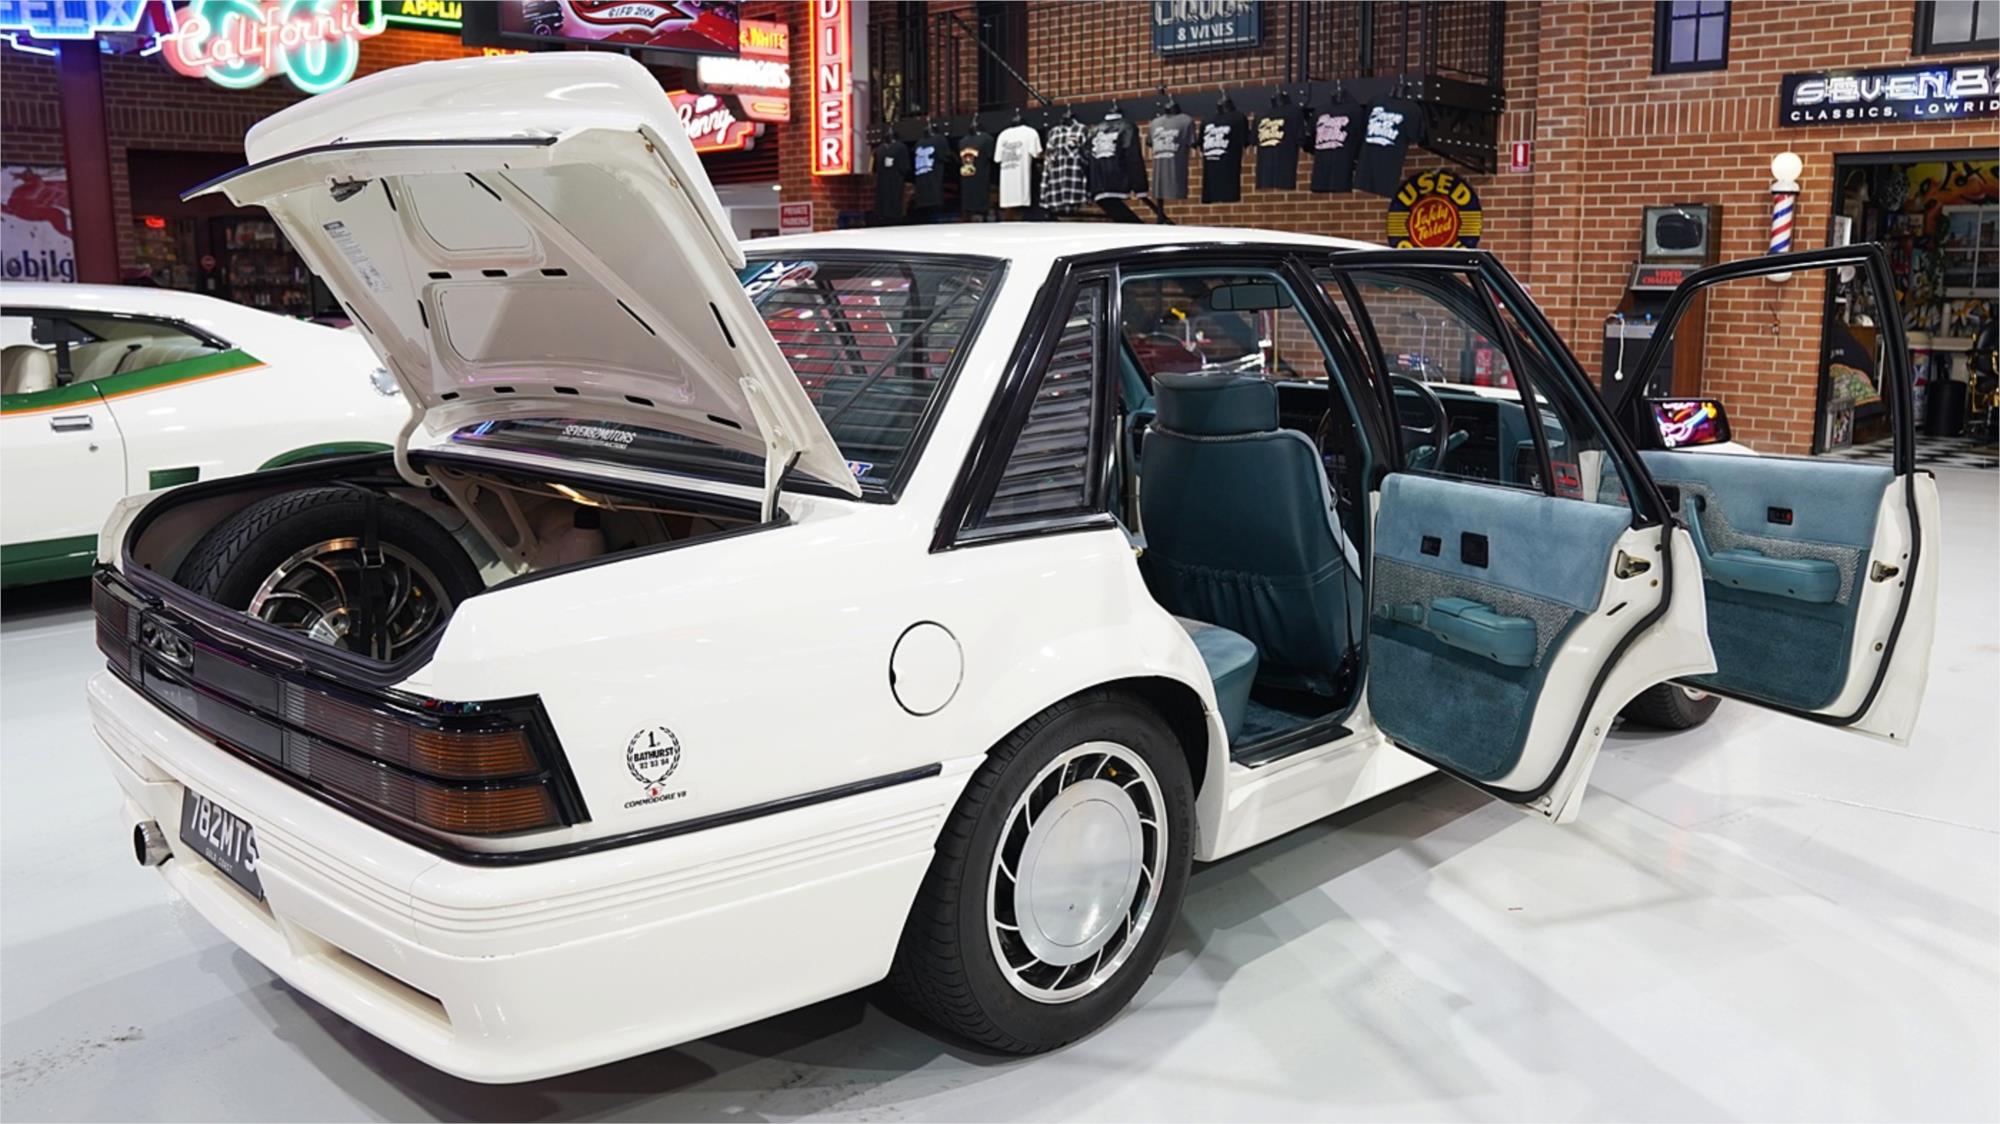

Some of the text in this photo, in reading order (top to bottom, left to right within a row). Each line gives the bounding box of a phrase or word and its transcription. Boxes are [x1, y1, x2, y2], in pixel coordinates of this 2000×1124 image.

[750, 28, 786, 48] WHITE
[820, 0, 841, 167] DINER
[1794, 67, 2000, 105] SEVEN8
[1790, 106, 1898, 121] CLASSICS,
[1397, 173, 1472, 206] USED
[0, 250, 74, 283] obilg
[633, 746, 674, 762] BATHURST
[624, 790, 687, 808] COMMODORE V8
[190, 790, 259, 873] 782MTS
